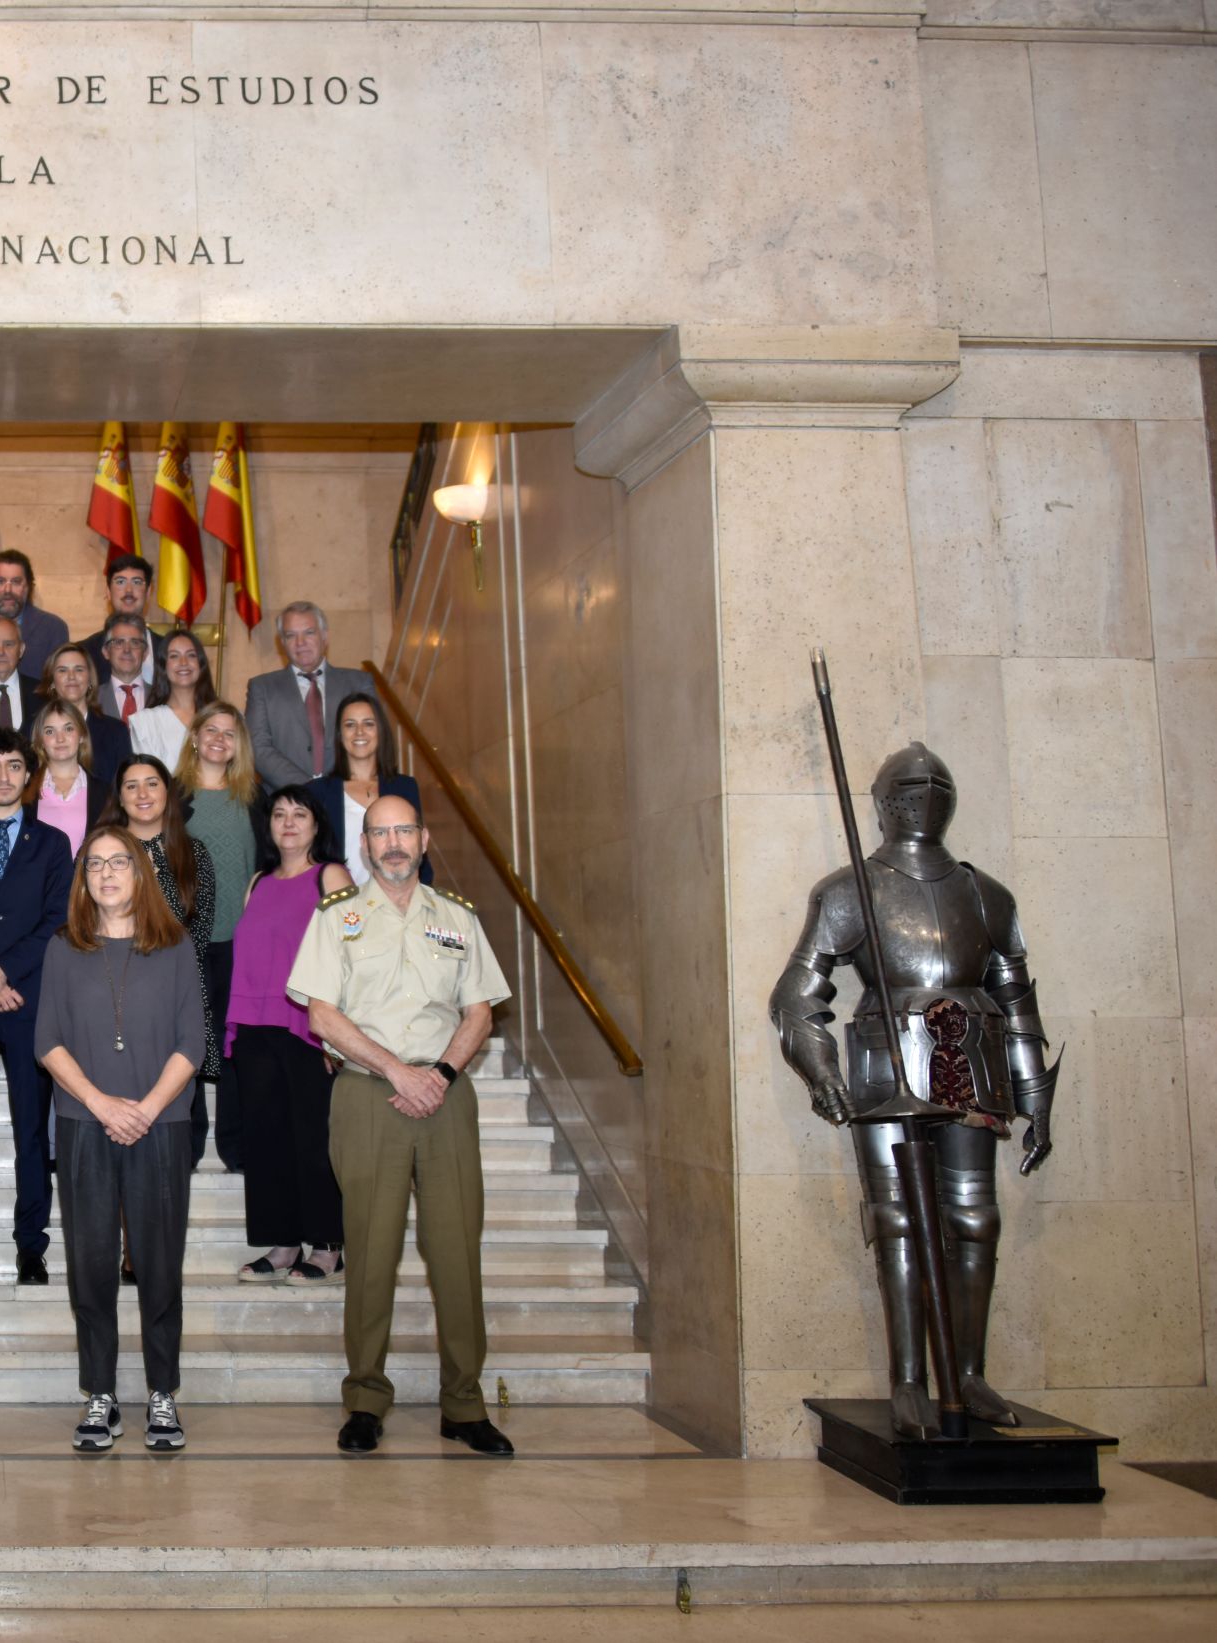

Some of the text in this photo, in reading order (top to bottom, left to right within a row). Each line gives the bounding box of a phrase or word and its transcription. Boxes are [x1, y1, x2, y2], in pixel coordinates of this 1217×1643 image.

[56, 75, 108, 106] DE
[146, 75, 380, 107] ESTUDIOS
[0, 234, 246, 267] NACIONAL
